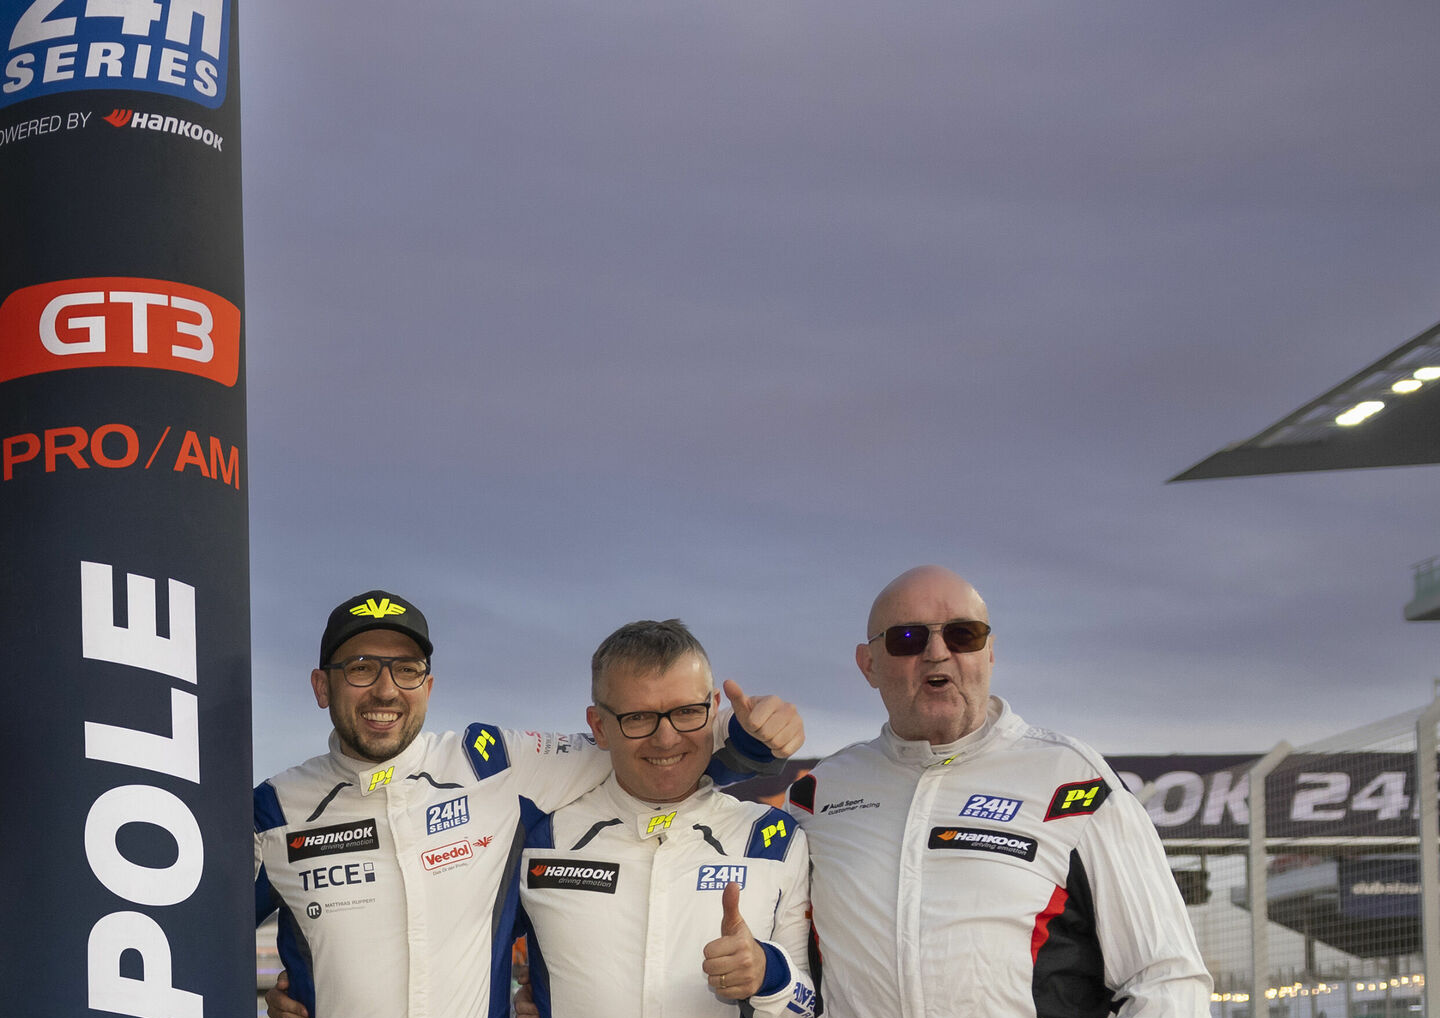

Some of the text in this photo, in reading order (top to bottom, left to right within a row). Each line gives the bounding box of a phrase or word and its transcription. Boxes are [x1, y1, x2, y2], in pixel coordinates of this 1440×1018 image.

[2, 42, 219, 98] SERIES
[66, 111, 92, 130] BY
[38, 290, 215, 364] GT3
[429, 797, 467, 826] 24H
[963, 808, 1011, 822] SERIES
[971, 796, 1017, 816] 24H
[429, 815, 469, 834] SERIES
[320, 838, 374, 851] driving emotion
[425, 844, 469, 866] Veedol
[299, 863, 362, 892] TECE
[700, 866, 745, 883] 24H
